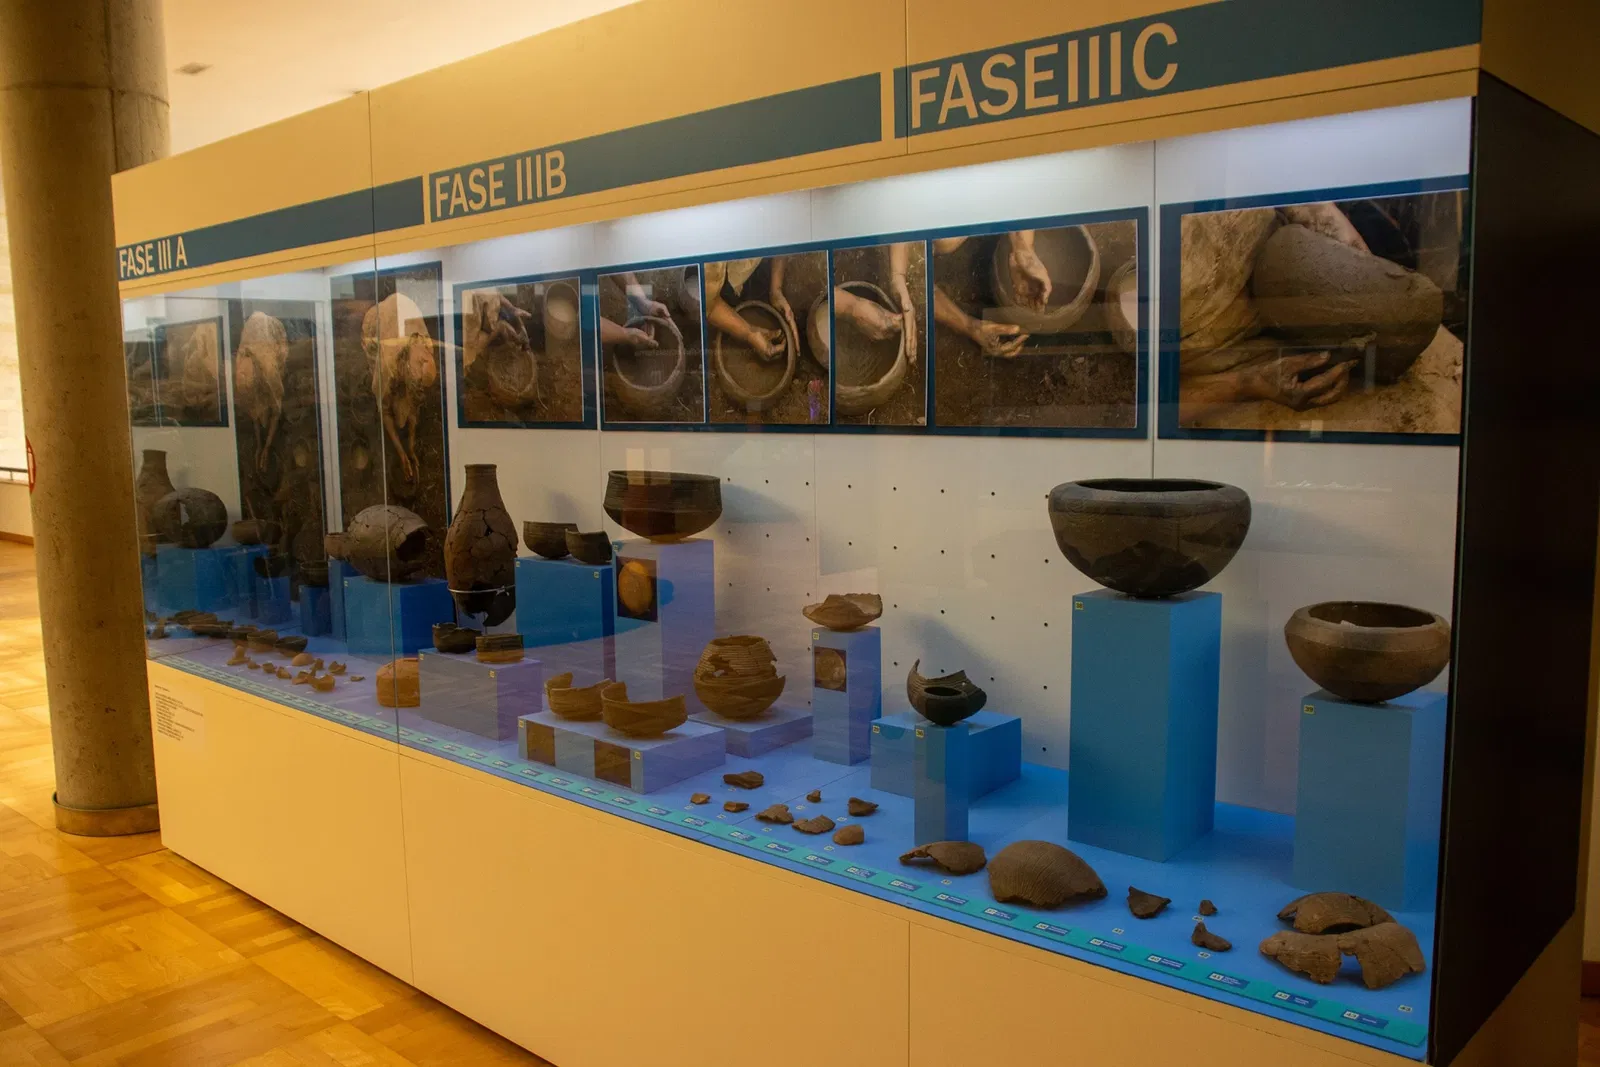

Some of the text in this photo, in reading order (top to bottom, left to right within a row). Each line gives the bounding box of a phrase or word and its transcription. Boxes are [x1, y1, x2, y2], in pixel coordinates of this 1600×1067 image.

[434, 149, 567, 217] FASE IIIB
[119, 235, 188, 278] FASE III A
